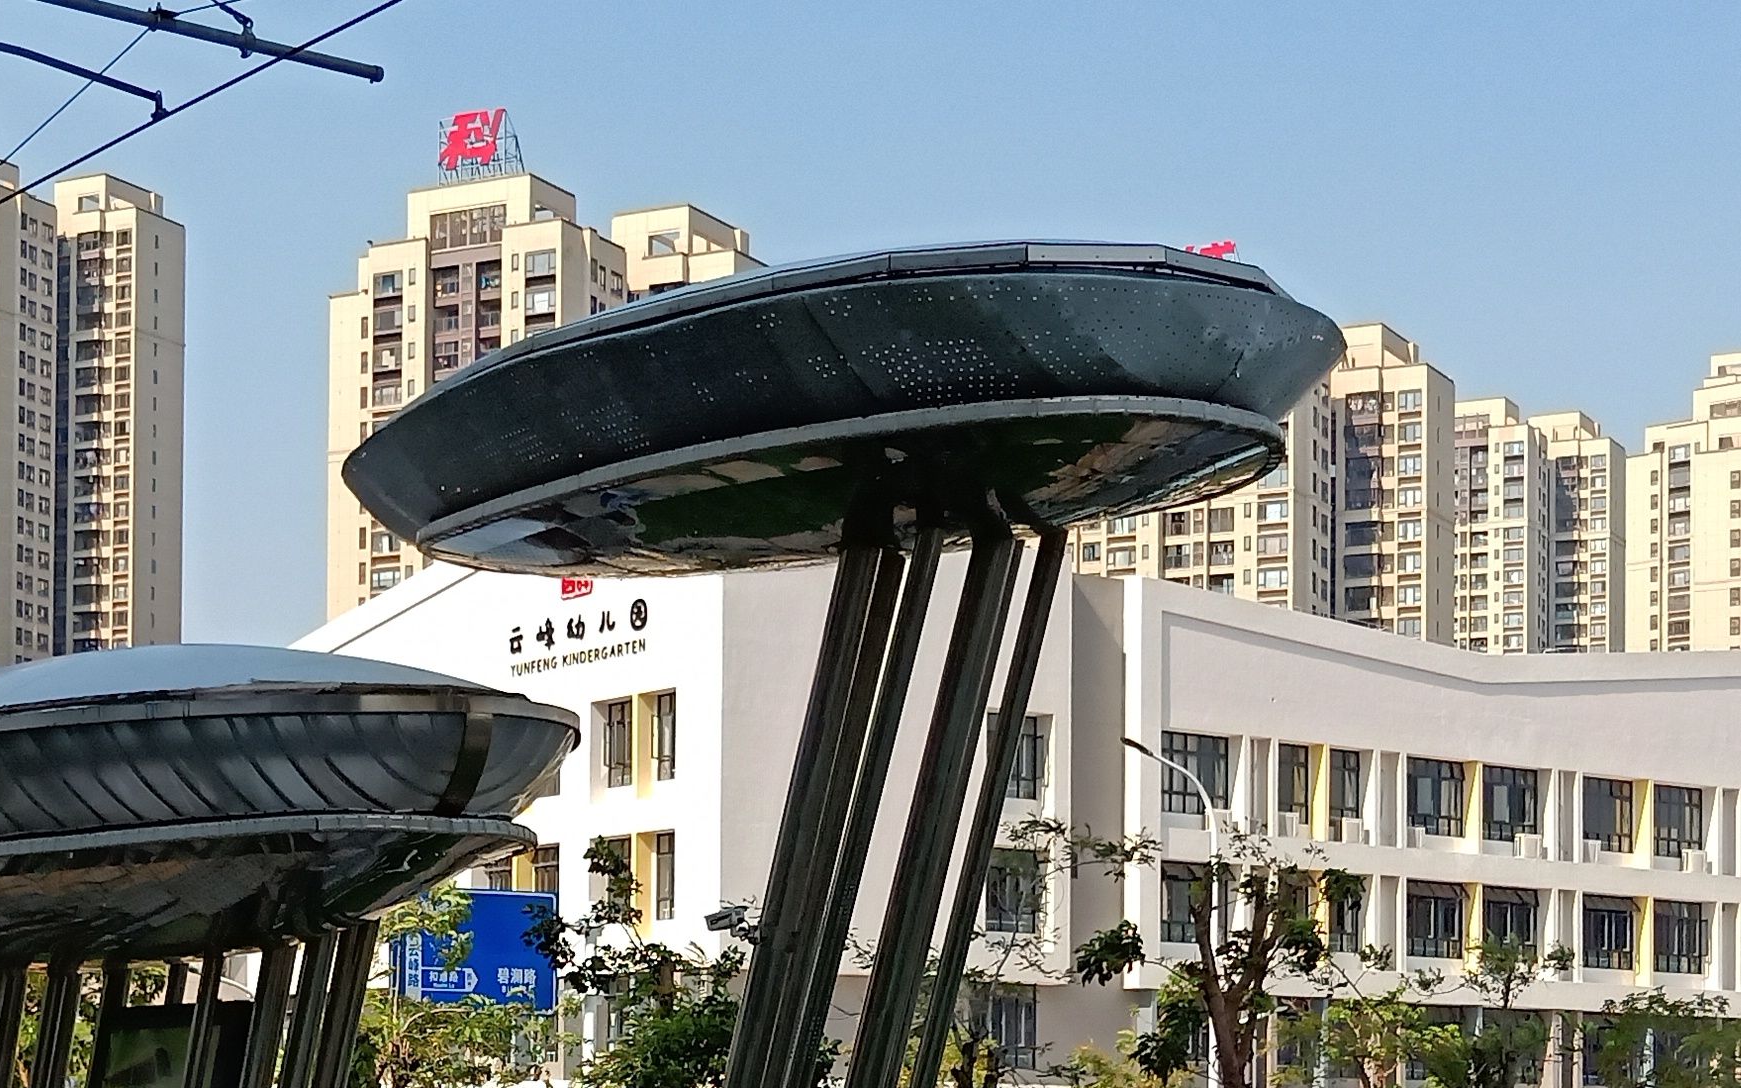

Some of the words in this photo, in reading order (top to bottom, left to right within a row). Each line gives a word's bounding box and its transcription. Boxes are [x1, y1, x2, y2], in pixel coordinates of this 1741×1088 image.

[509, 598, 648, 655] 云峰幼儿园
[510, 656, 558, 678] YUNFENG
[562, 638, 646, 668] KINDERGARTEN
